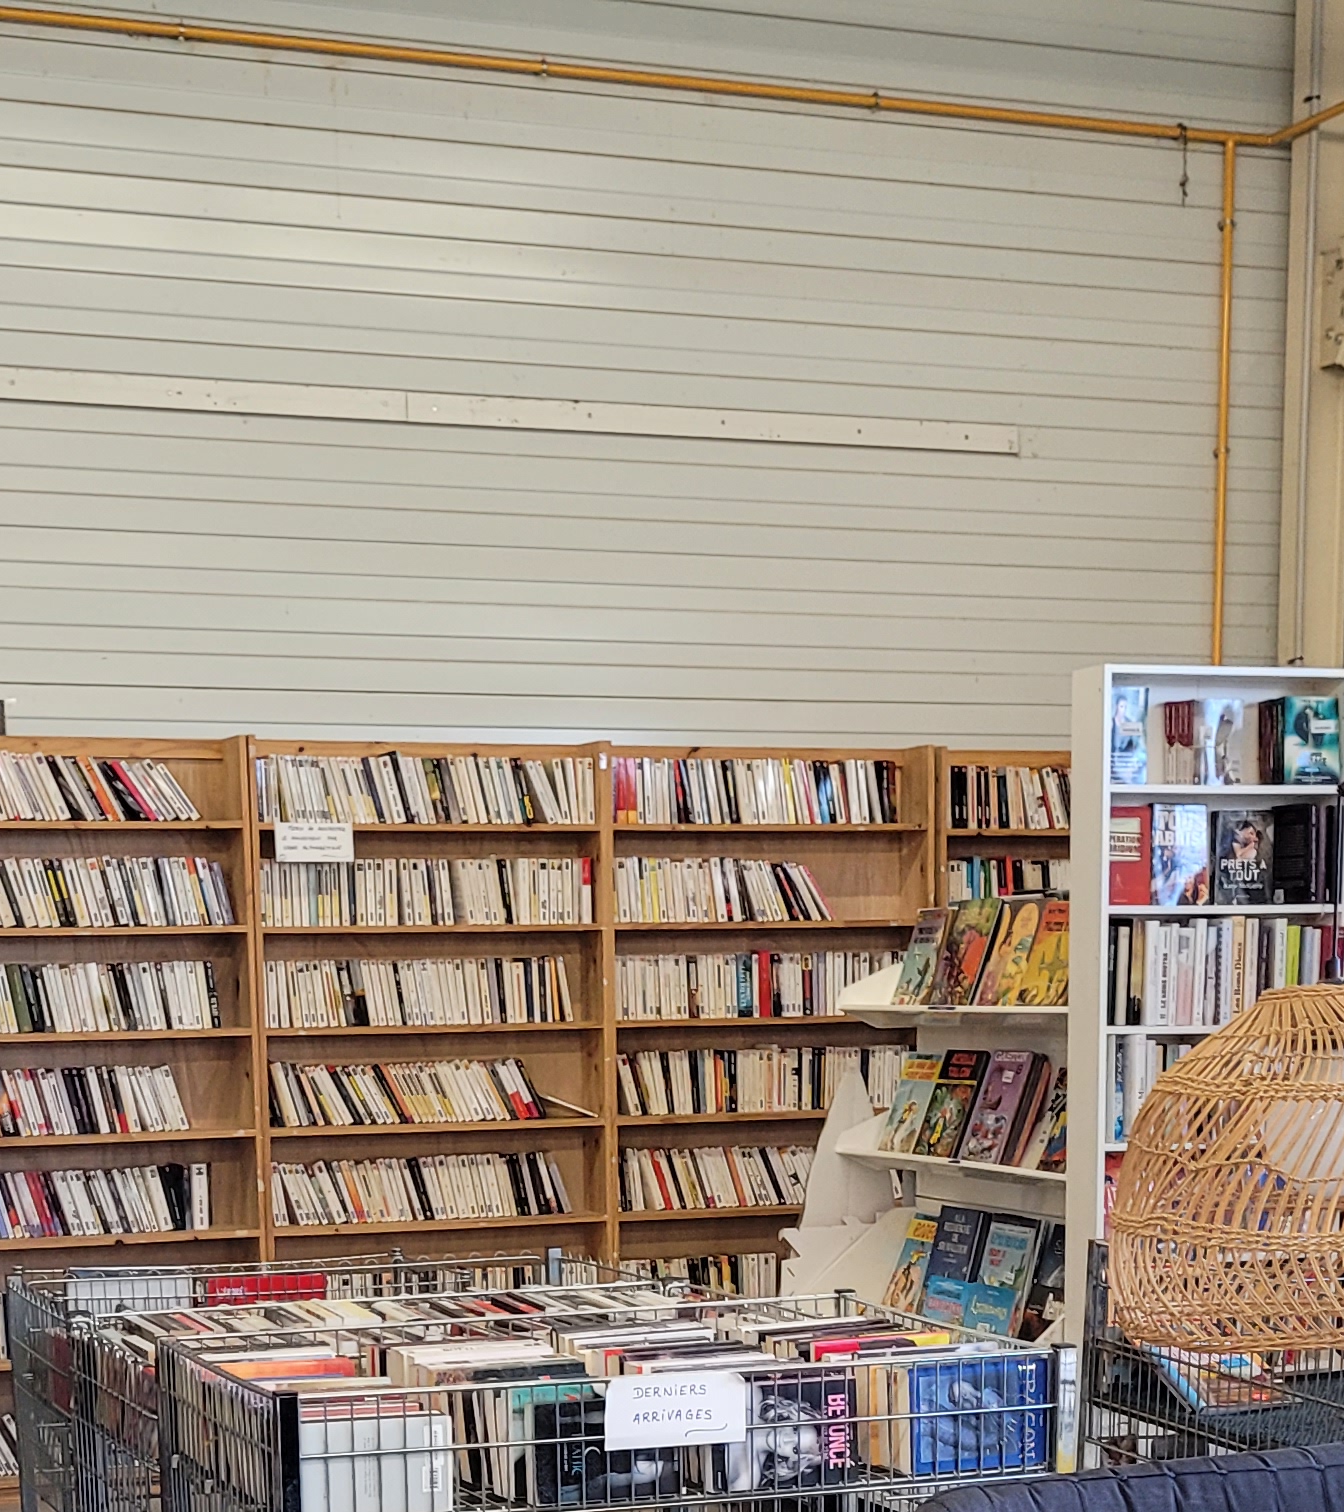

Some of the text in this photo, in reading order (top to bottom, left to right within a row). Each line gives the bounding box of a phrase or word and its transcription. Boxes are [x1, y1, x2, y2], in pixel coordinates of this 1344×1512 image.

[1227, 870, 1260, 882] TOUT
[632, 1383, 707, 1400] DERNIERS
[632, 1408, 713, 1425] ARRIVAGES
